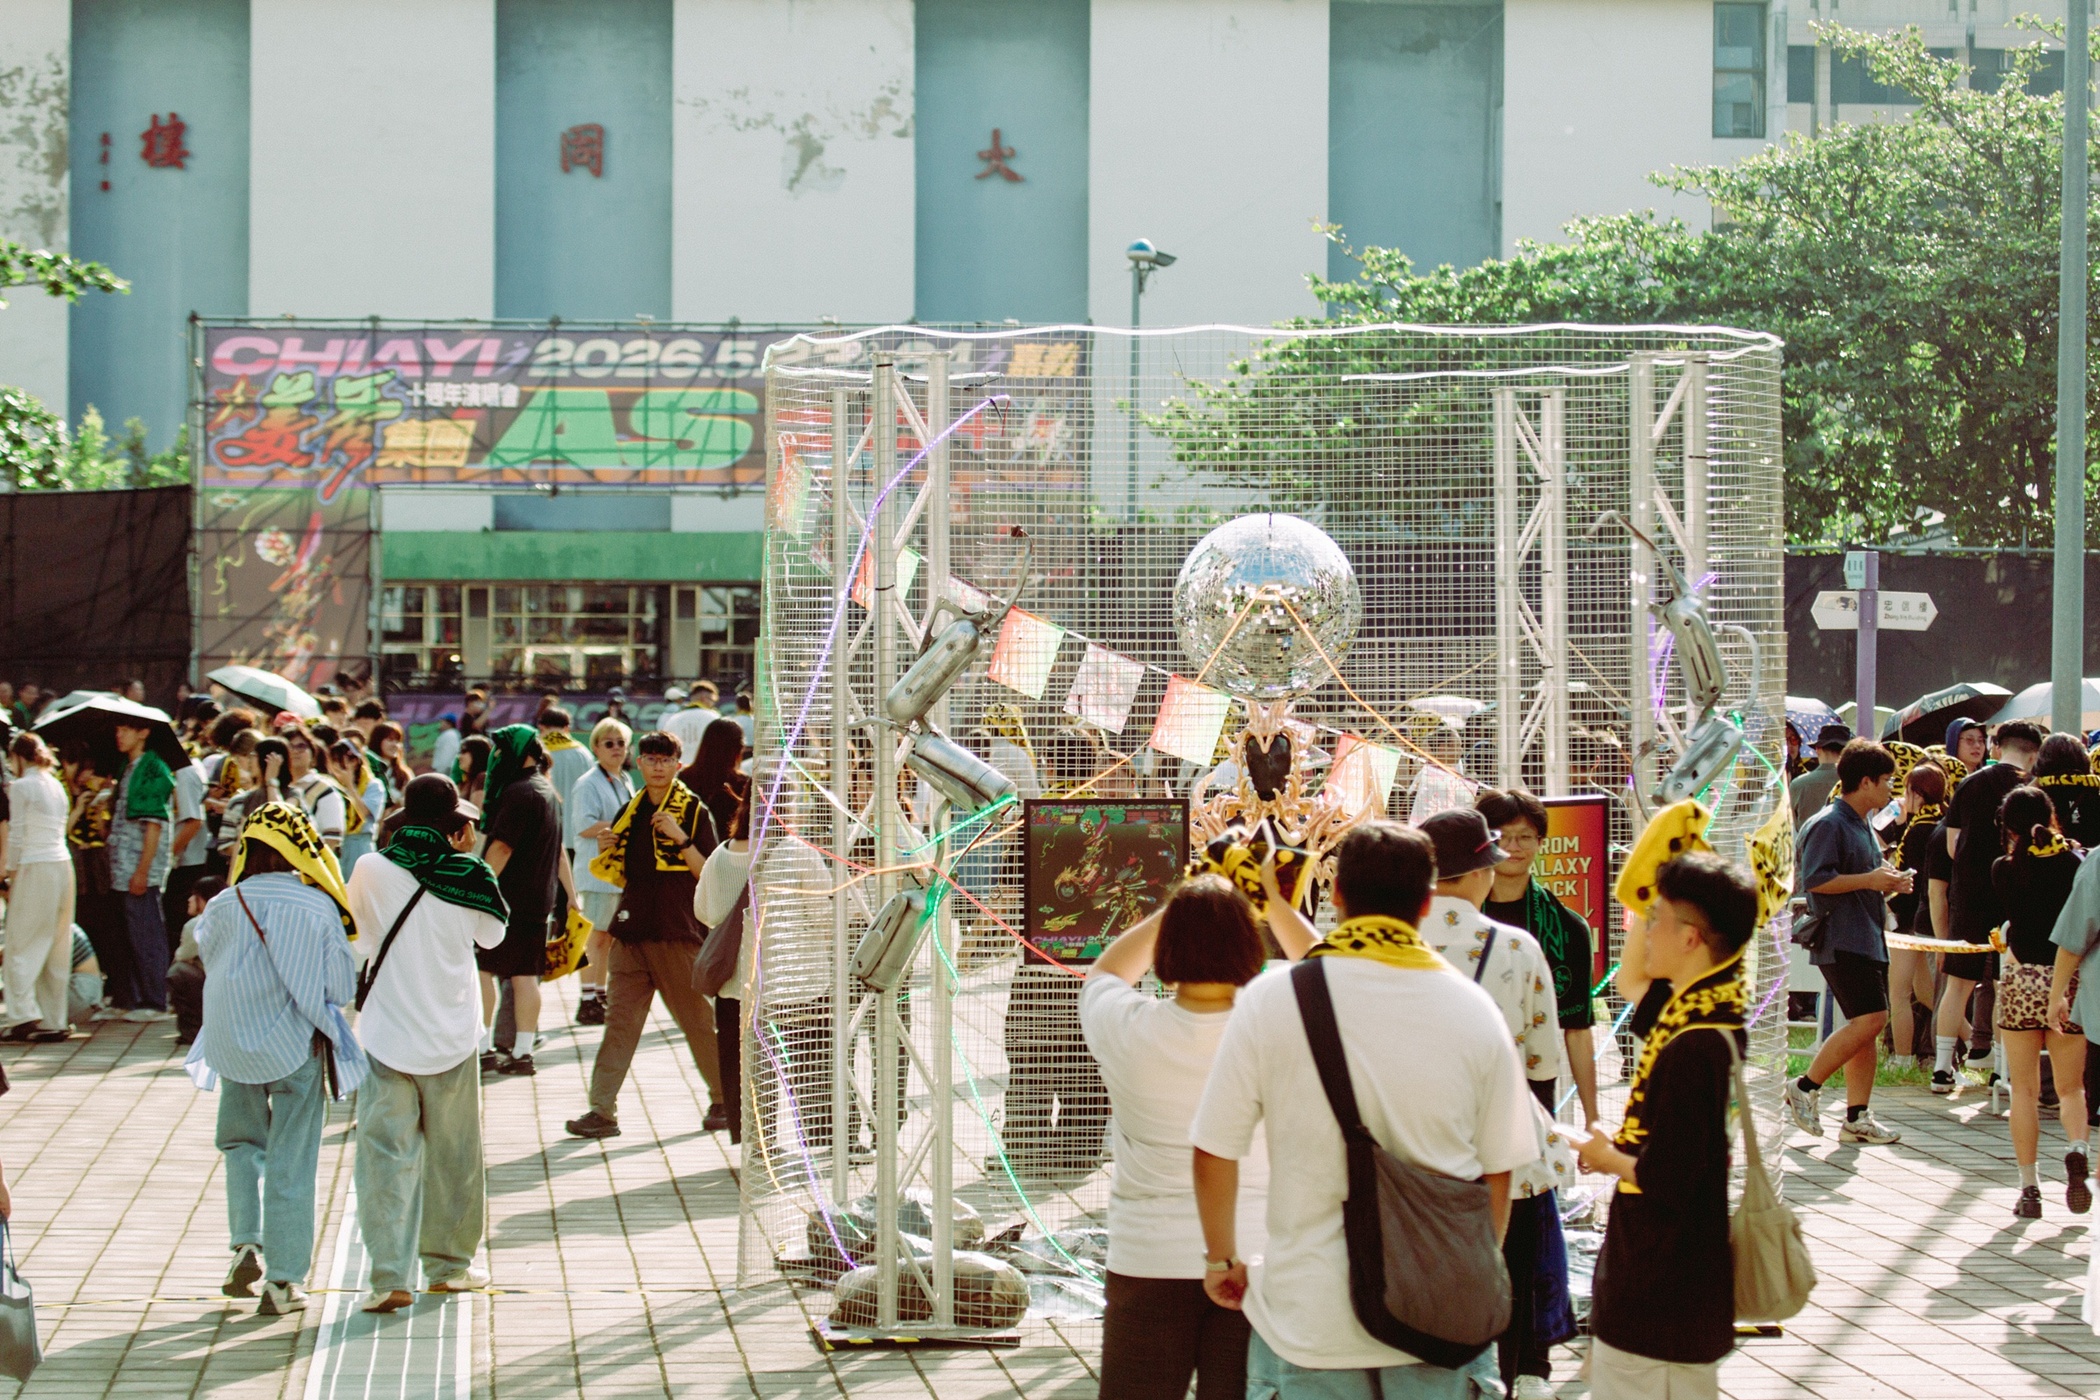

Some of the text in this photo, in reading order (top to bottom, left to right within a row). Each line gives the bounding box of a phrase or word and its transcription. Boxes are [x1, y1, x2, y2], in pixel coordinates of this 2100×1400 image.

[975, 127, 1026, 183] 大
[211, 336, 503, 378] CHIAYI
[1539, 835, 1579, 854] ROM
[1528, 857, 1592, 876] ALAXY
[420, 877, 493, 904] AMAZING SHOW
